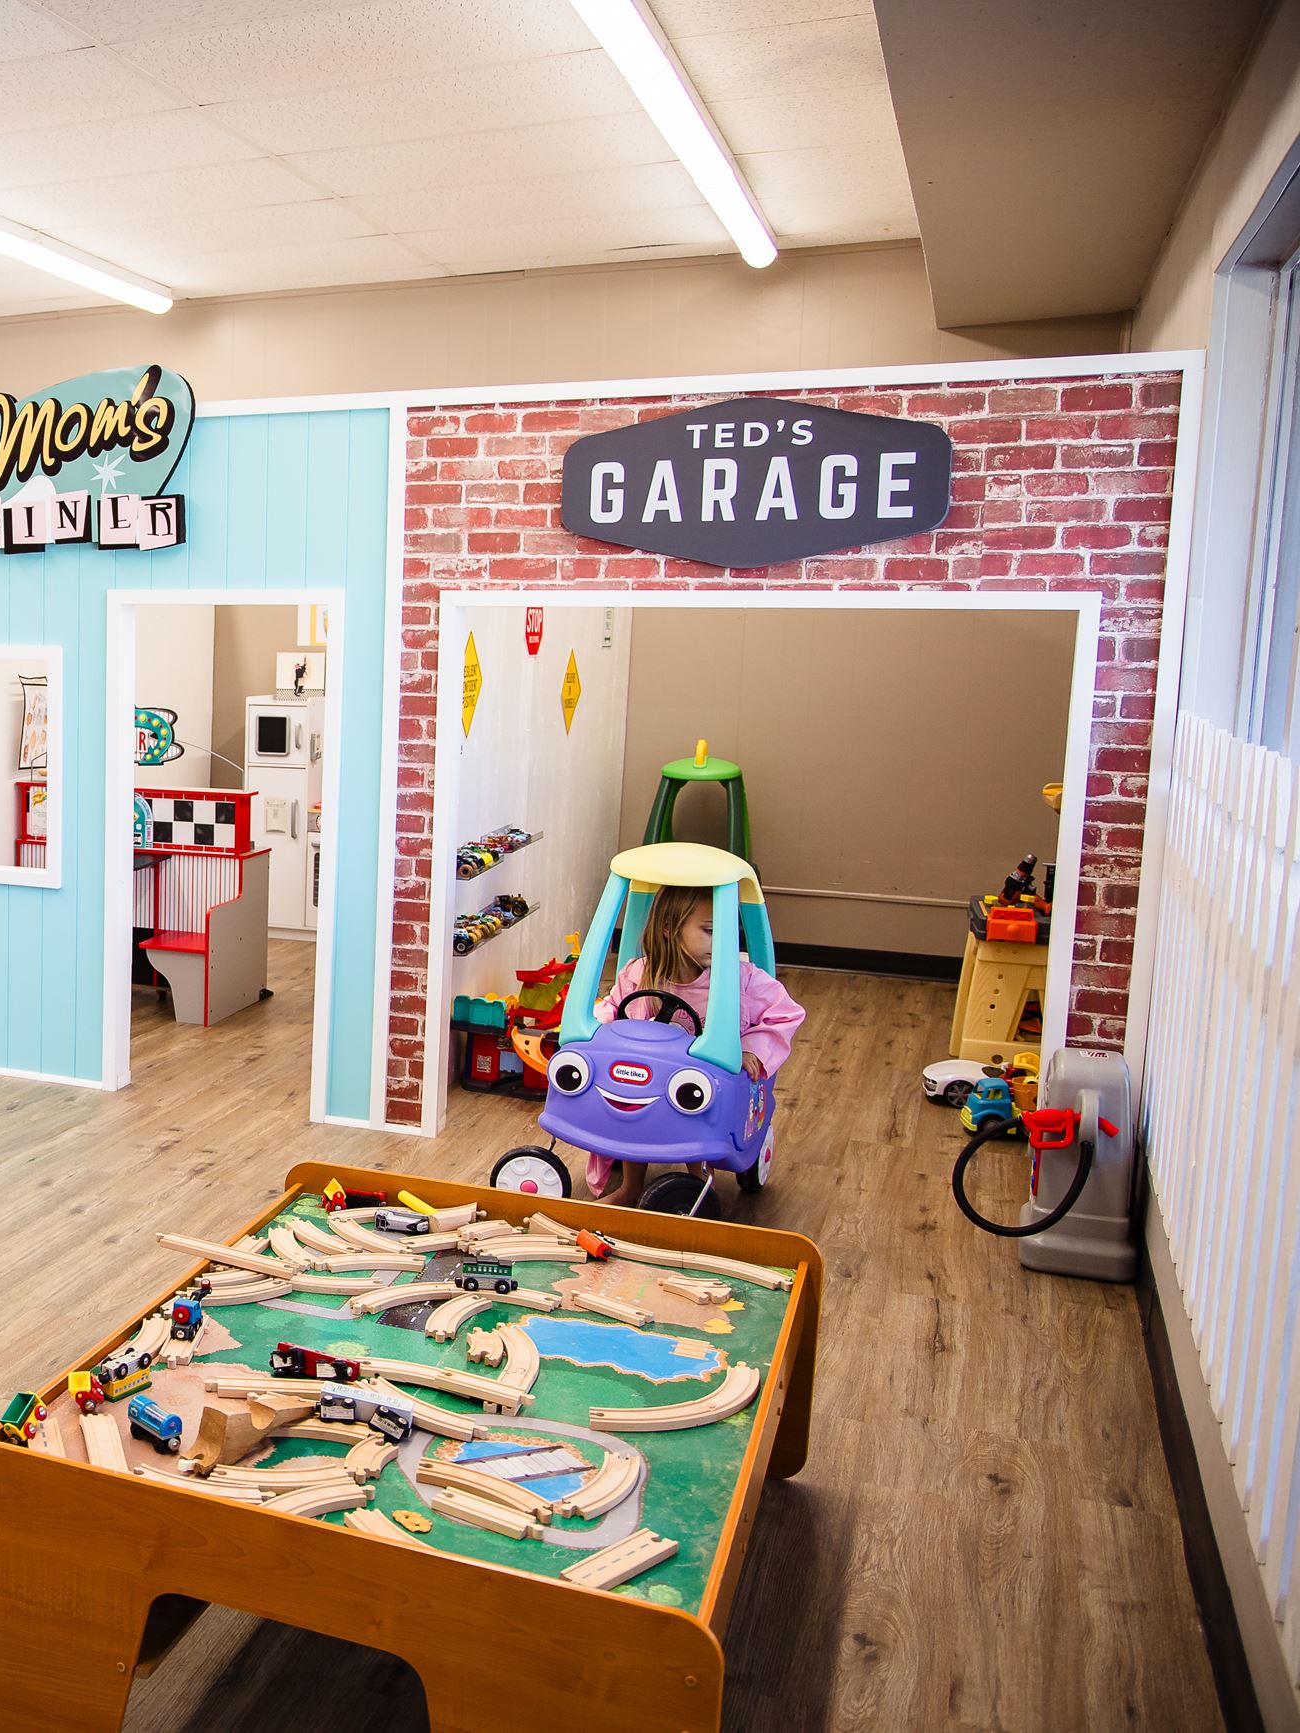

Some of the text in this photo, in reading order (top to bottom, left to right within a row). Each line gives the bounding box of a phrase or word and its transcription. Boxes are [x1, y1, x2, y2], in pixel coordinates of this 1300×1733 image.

[686, 419, 814, 449] TED'S
[589, 452, 917, 524] GARAGE
[527, 609, 543, 633] STOP
[616, 1068, 645, 1078] little tikes
